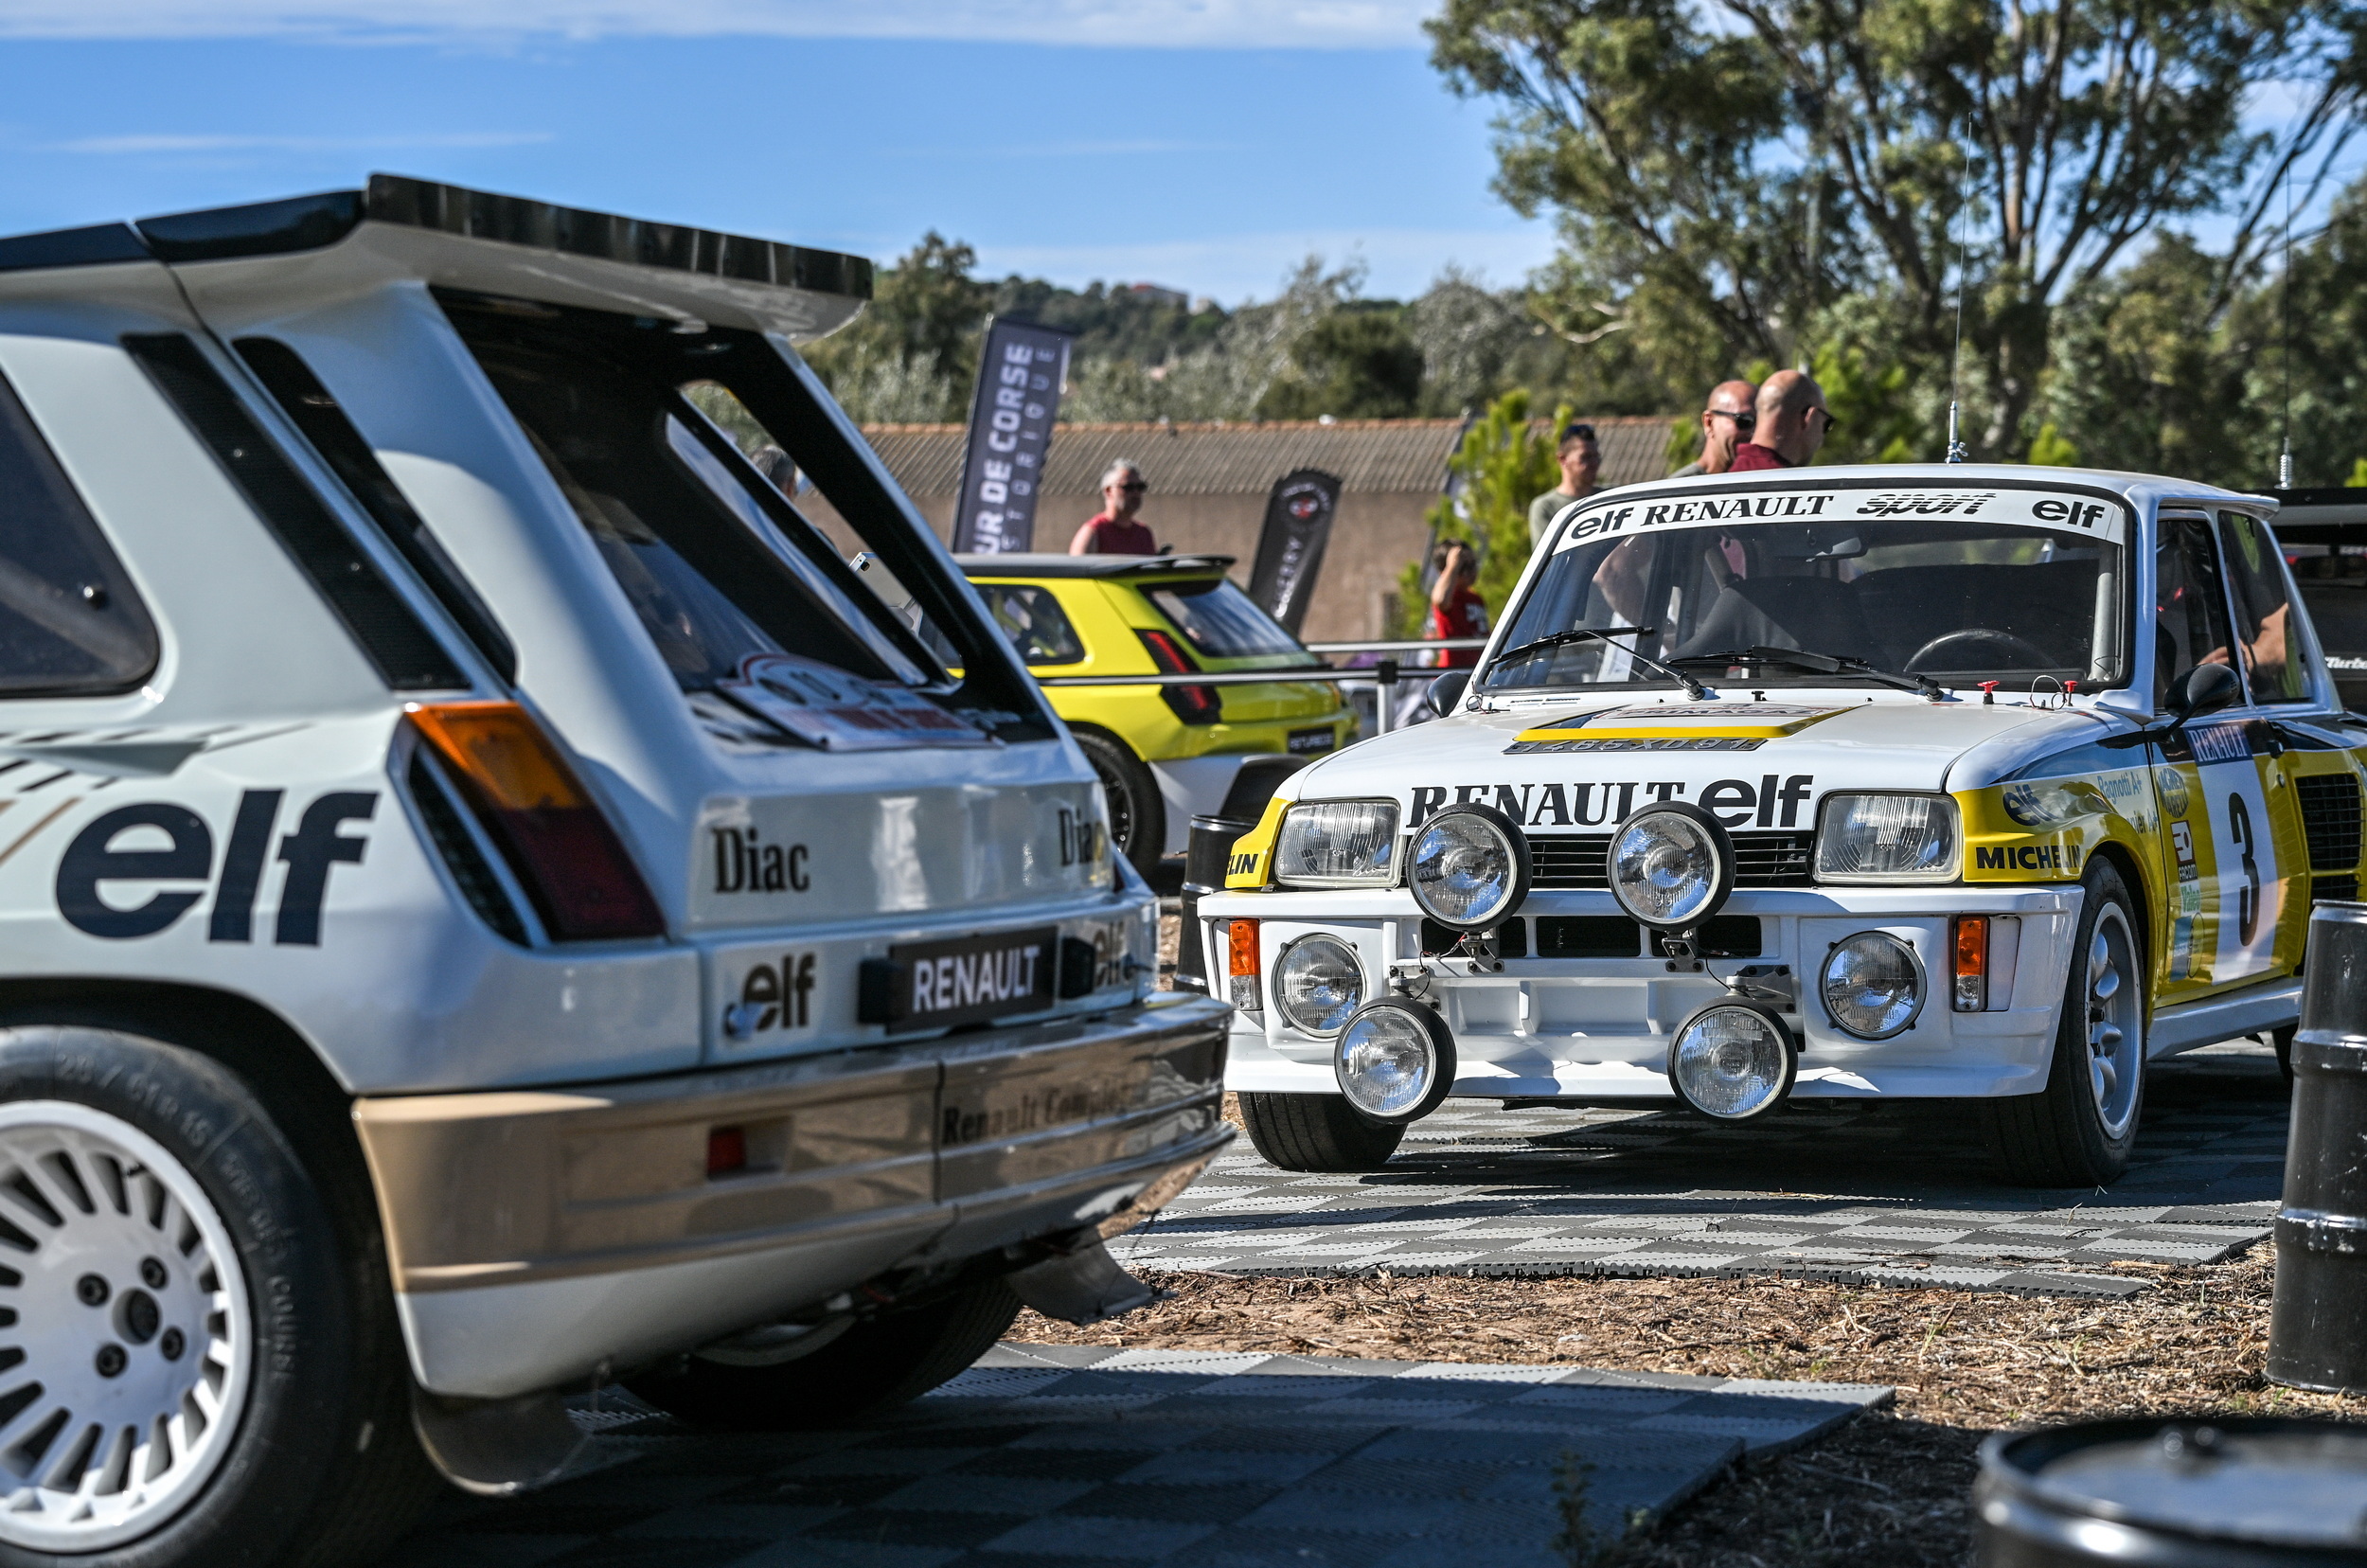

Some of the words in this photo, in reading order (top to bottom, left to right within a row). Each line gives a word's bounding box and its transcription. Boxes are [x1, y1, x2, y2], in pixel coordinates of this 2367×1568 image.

[988, 342, 1034, 453] CORSE
[980, 459, 1012, 505] DE
[1001, 348, 1056, 551] STORIQUE
[972, 509, 1005, 554] UR
[1571, 507, 1634, 539] elf
[1640, 495, 1834, 526] RENAULT
[1856, 492, 1997, 517] sport
[2032, 499, 2105, 528] elf
[2188, 725, 2248, 762] RENAULT
[1699, 775, 1814, 828] elf
[2002, 783, 2058, 827] elf
[56, 788, 382, 948] elf
[712, 827, 810, 893] Diac
[2228, 792, 2260, 947] 3
[742, 952, 817, 1031] elf
[912, 945, 1041, 1013] RENAULT
